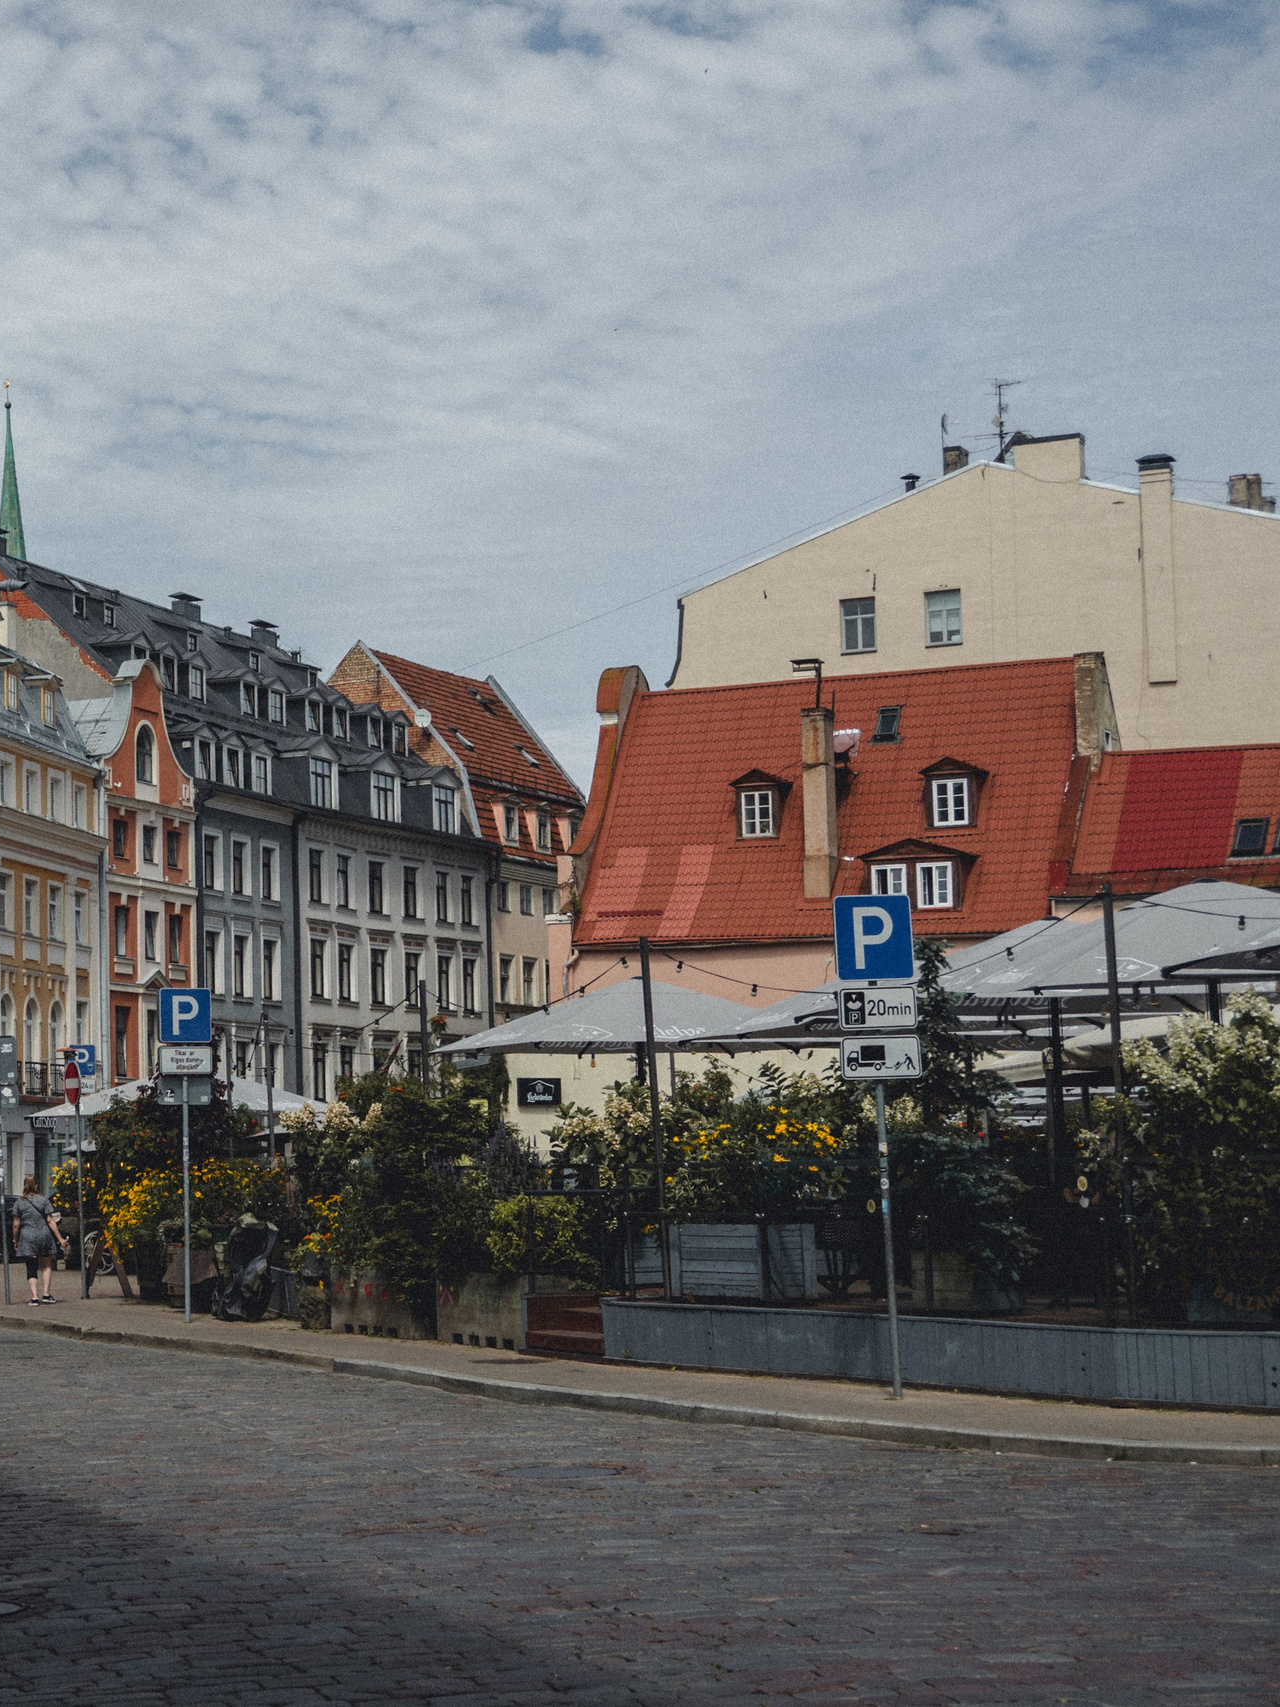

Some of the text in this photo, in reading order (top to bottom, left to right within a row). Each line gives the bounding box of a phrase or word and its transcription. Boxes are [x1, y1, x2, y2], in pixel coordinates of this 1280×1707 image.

[852, 906, 893, 970] P
[172, 995, 199, 1036] P
[849, 1013, 859, 1024] P
[867, 999, 912, 1016] 20min
[1213, 1284, 1280, 1312] BALZAM
